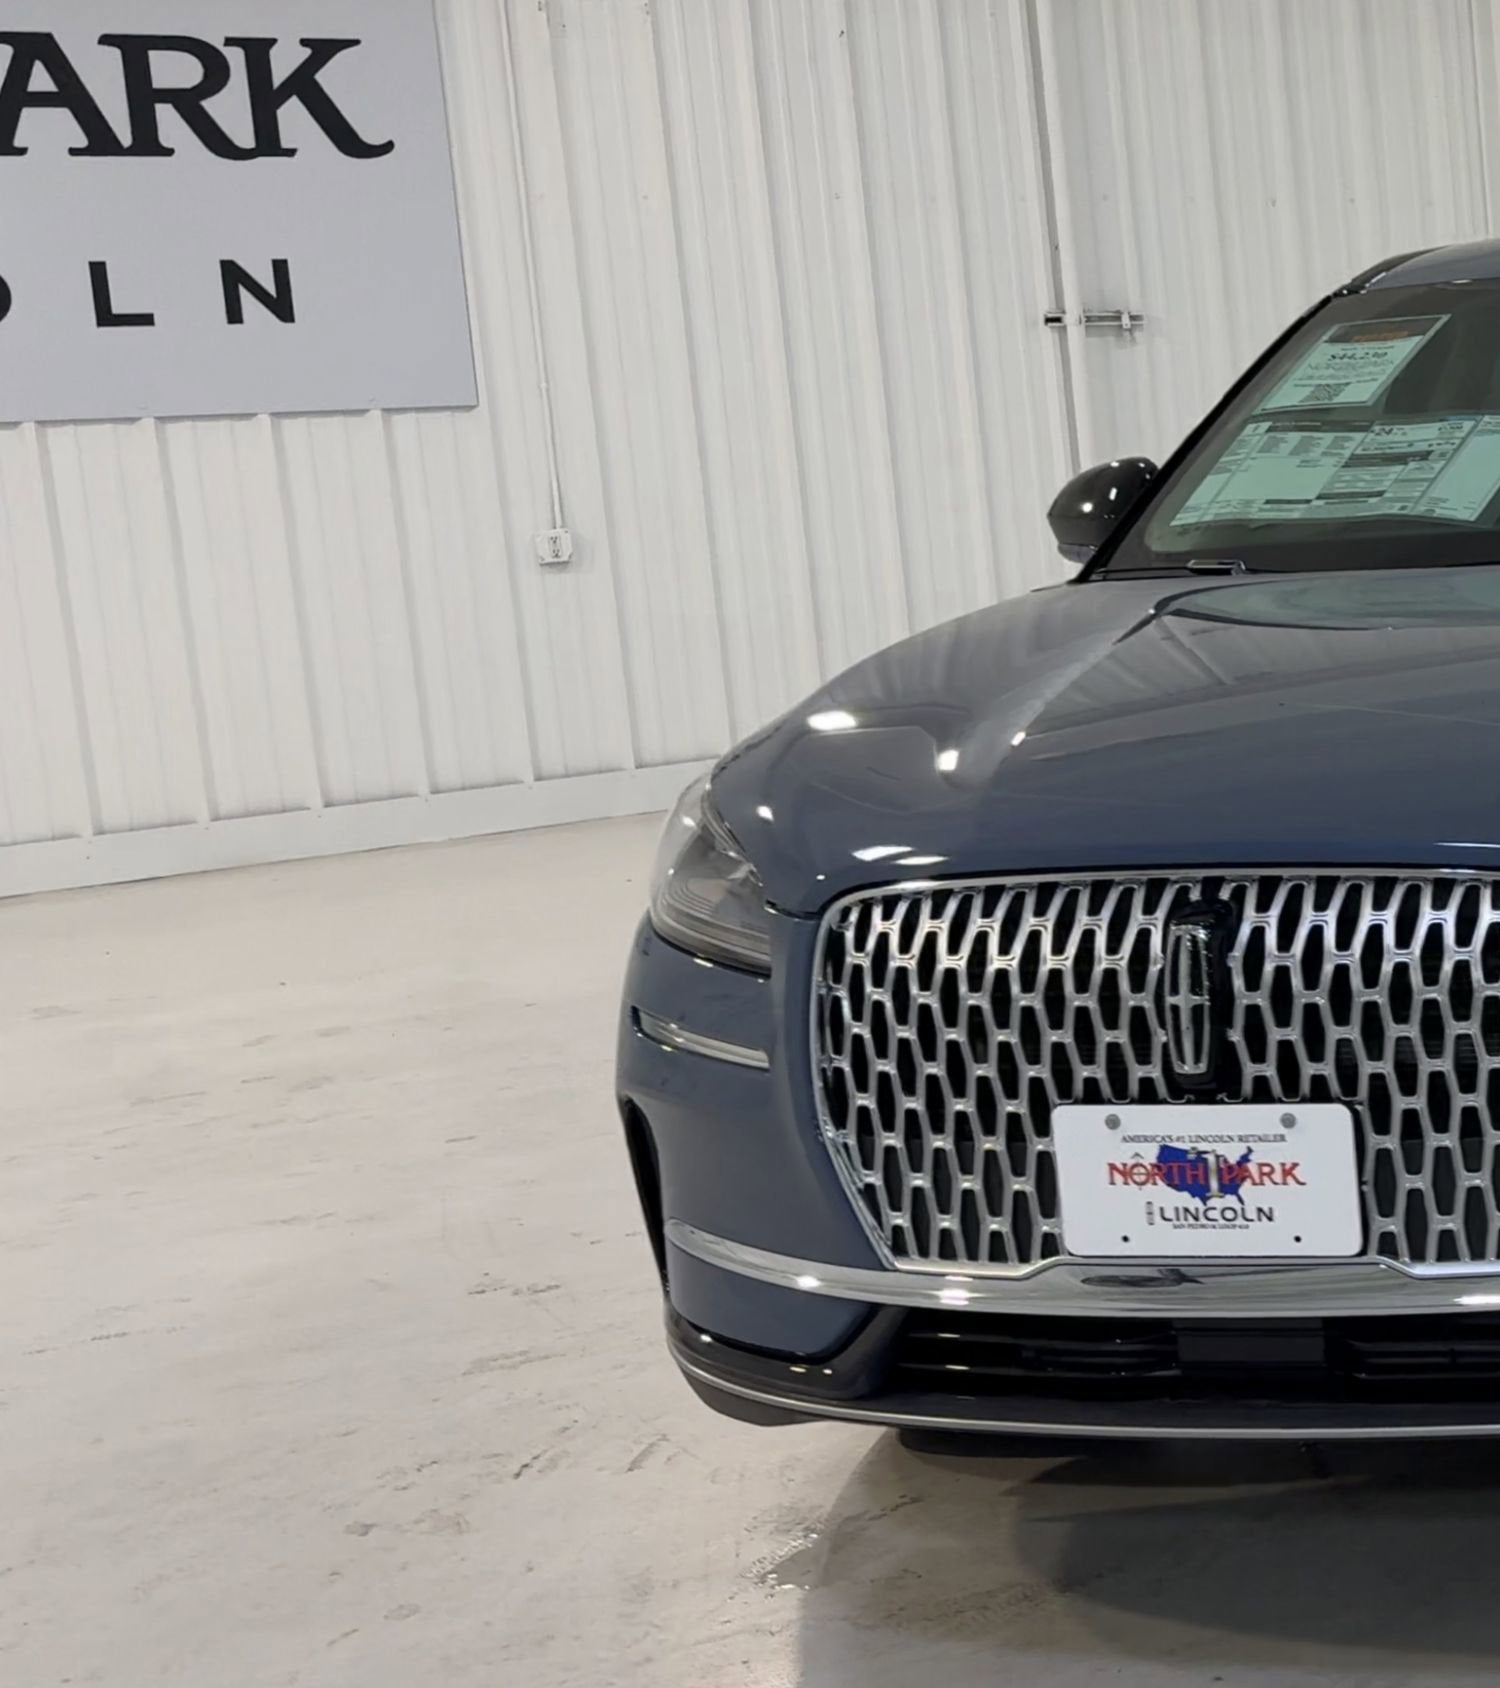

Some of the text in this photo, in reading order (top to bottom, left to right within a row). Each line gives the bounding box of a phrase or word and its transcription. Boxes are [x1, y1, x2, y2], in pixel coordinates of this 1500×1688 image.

[1121, 1134, 1173, 1143] AMERICA'S
[1189, 1134, 1234, 1143] LINCOLN
[1237, 1134, 1287, 1143] RETAILER
[1108, 1161, 1206, 1186] NORTH
[1221, 1161, 1306, 1186] PARK
[1159, 1206, 1275, 1222] LINCOLN
